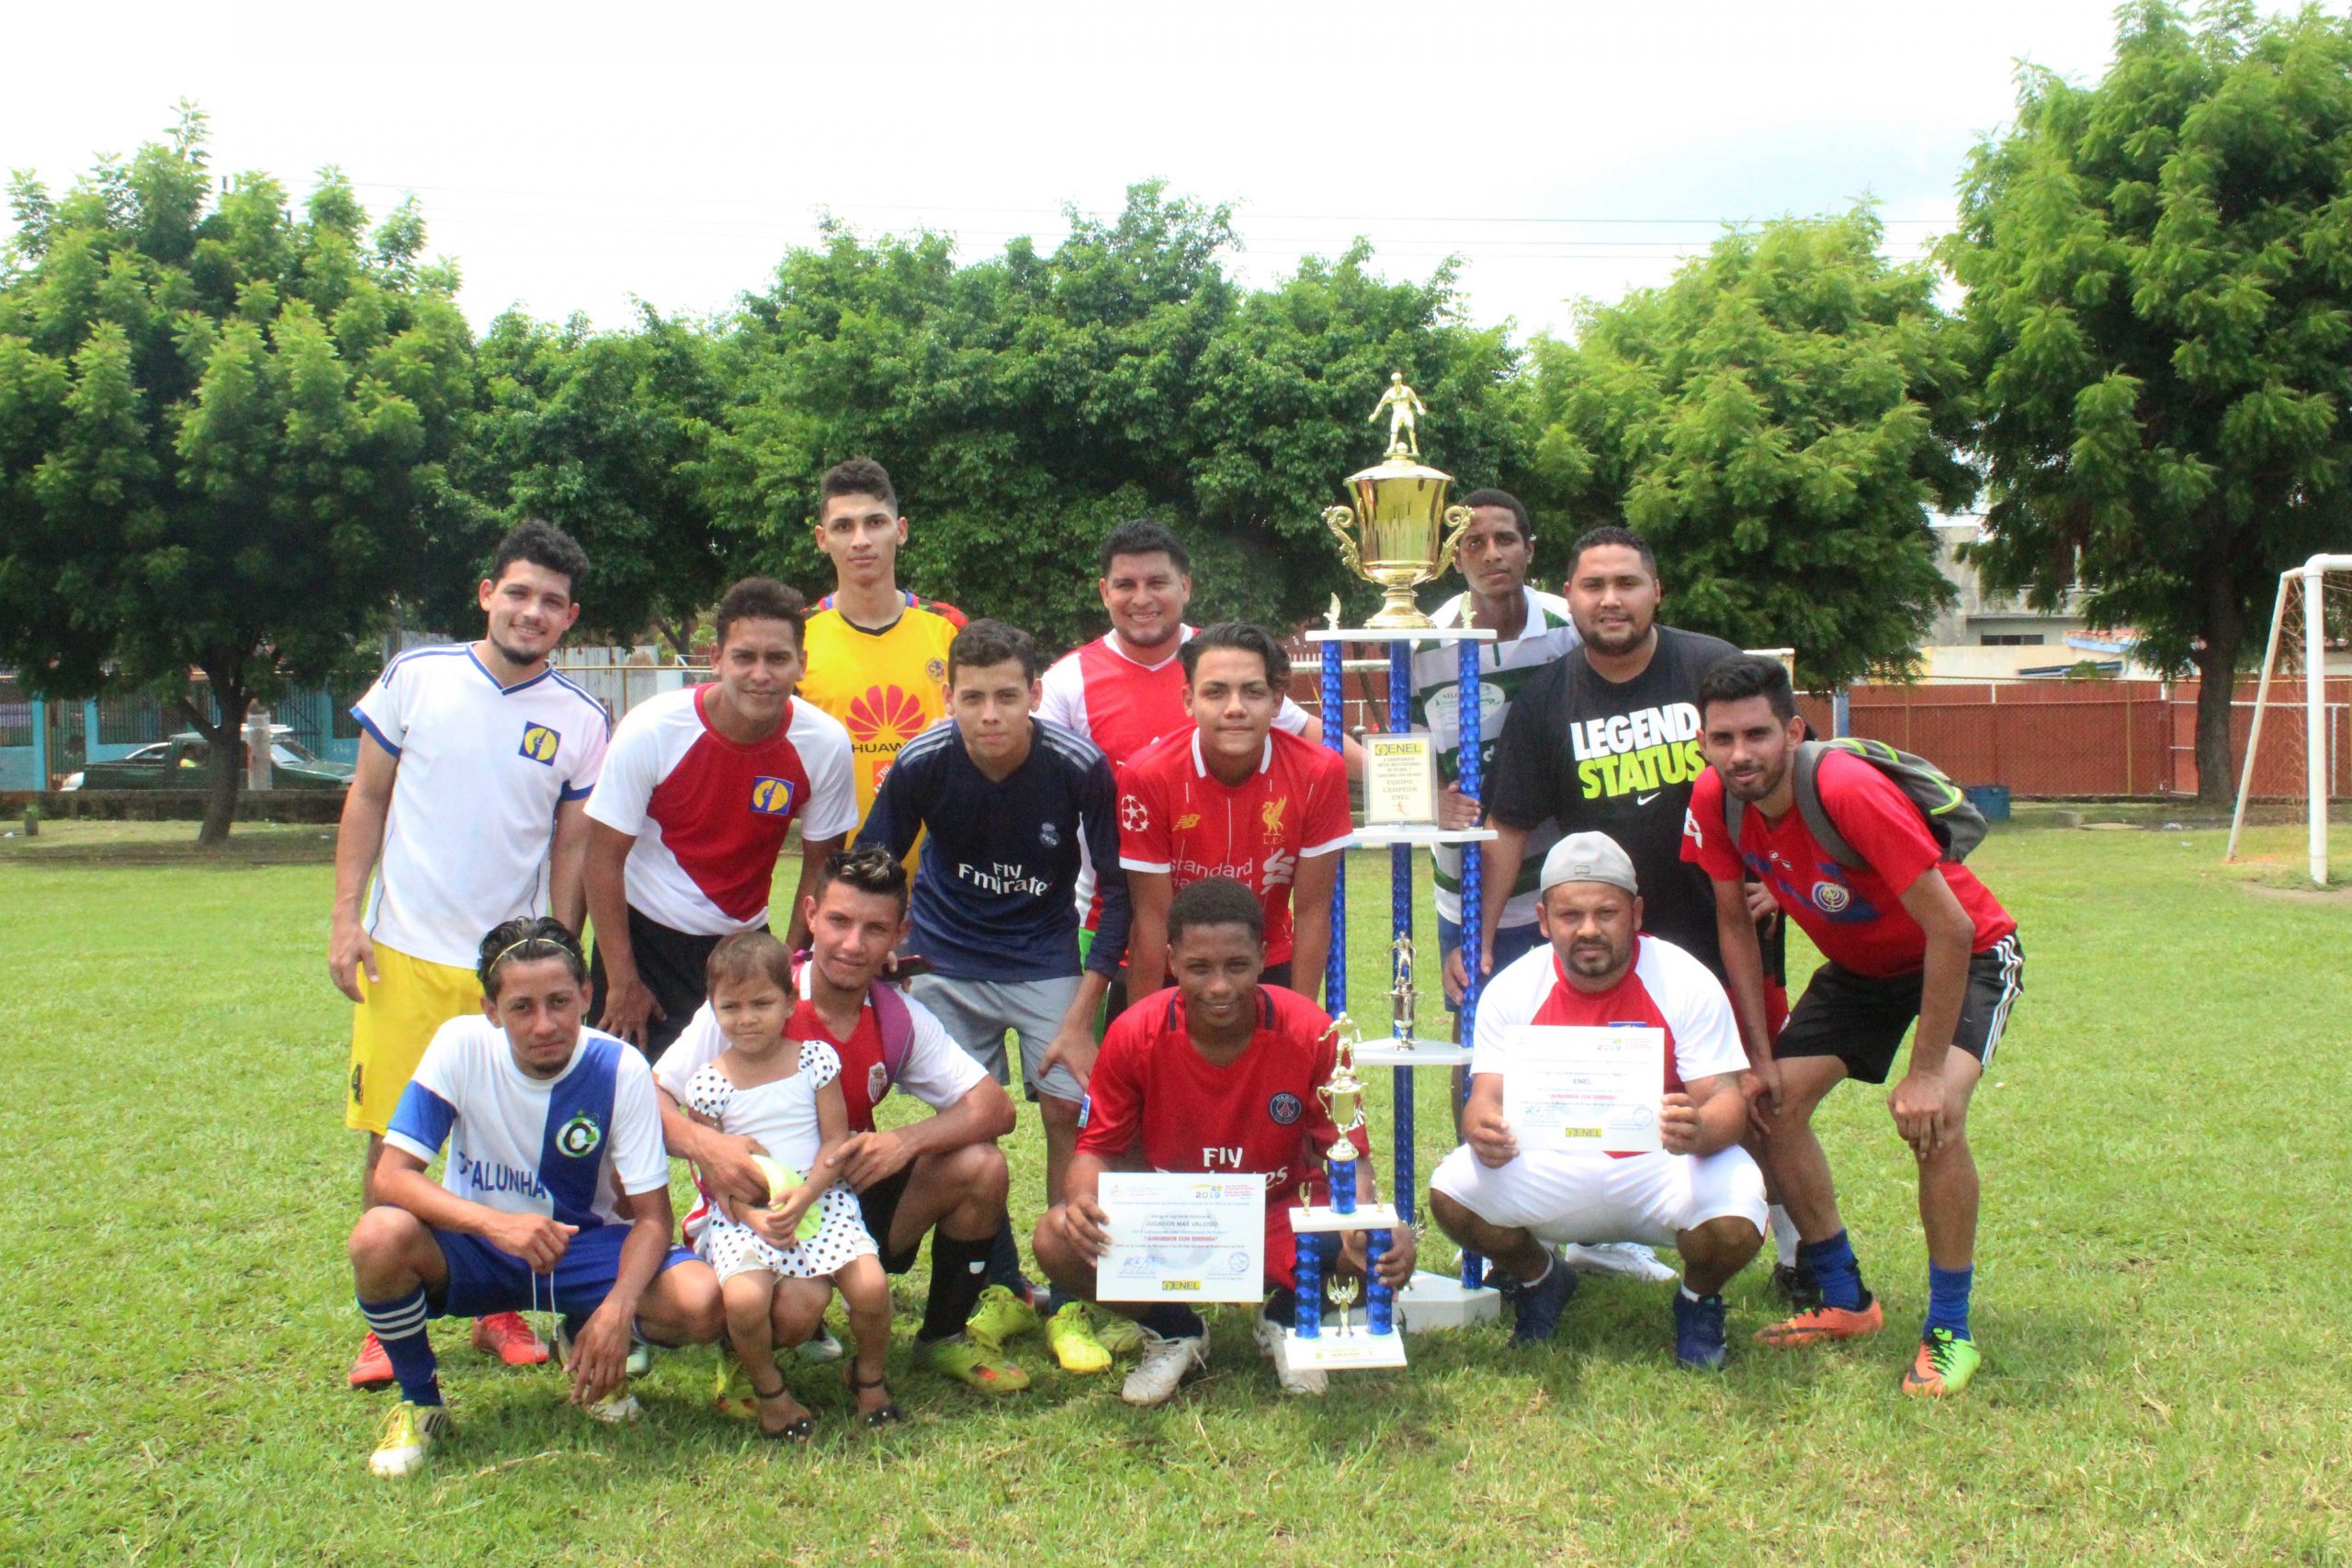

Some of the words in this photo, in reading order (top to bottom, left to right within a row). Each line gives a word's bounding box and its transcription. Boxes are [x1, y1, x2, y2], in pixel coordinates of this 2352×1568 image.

[1570, 703, 1701, 761] LEGEND
[1387, 743, 1422, 753] ENEL
[1578, 740, 1705, 799] STATUS
[958, 863, 1053, 896] Emirate
[993, 863, 1023, 879] Fly
[1576, 1128, 1602, 1136] ENEL
[1203, 1147, 1243, 1168] Fly
[1172, 1281, 1200, 1290] ENEL
